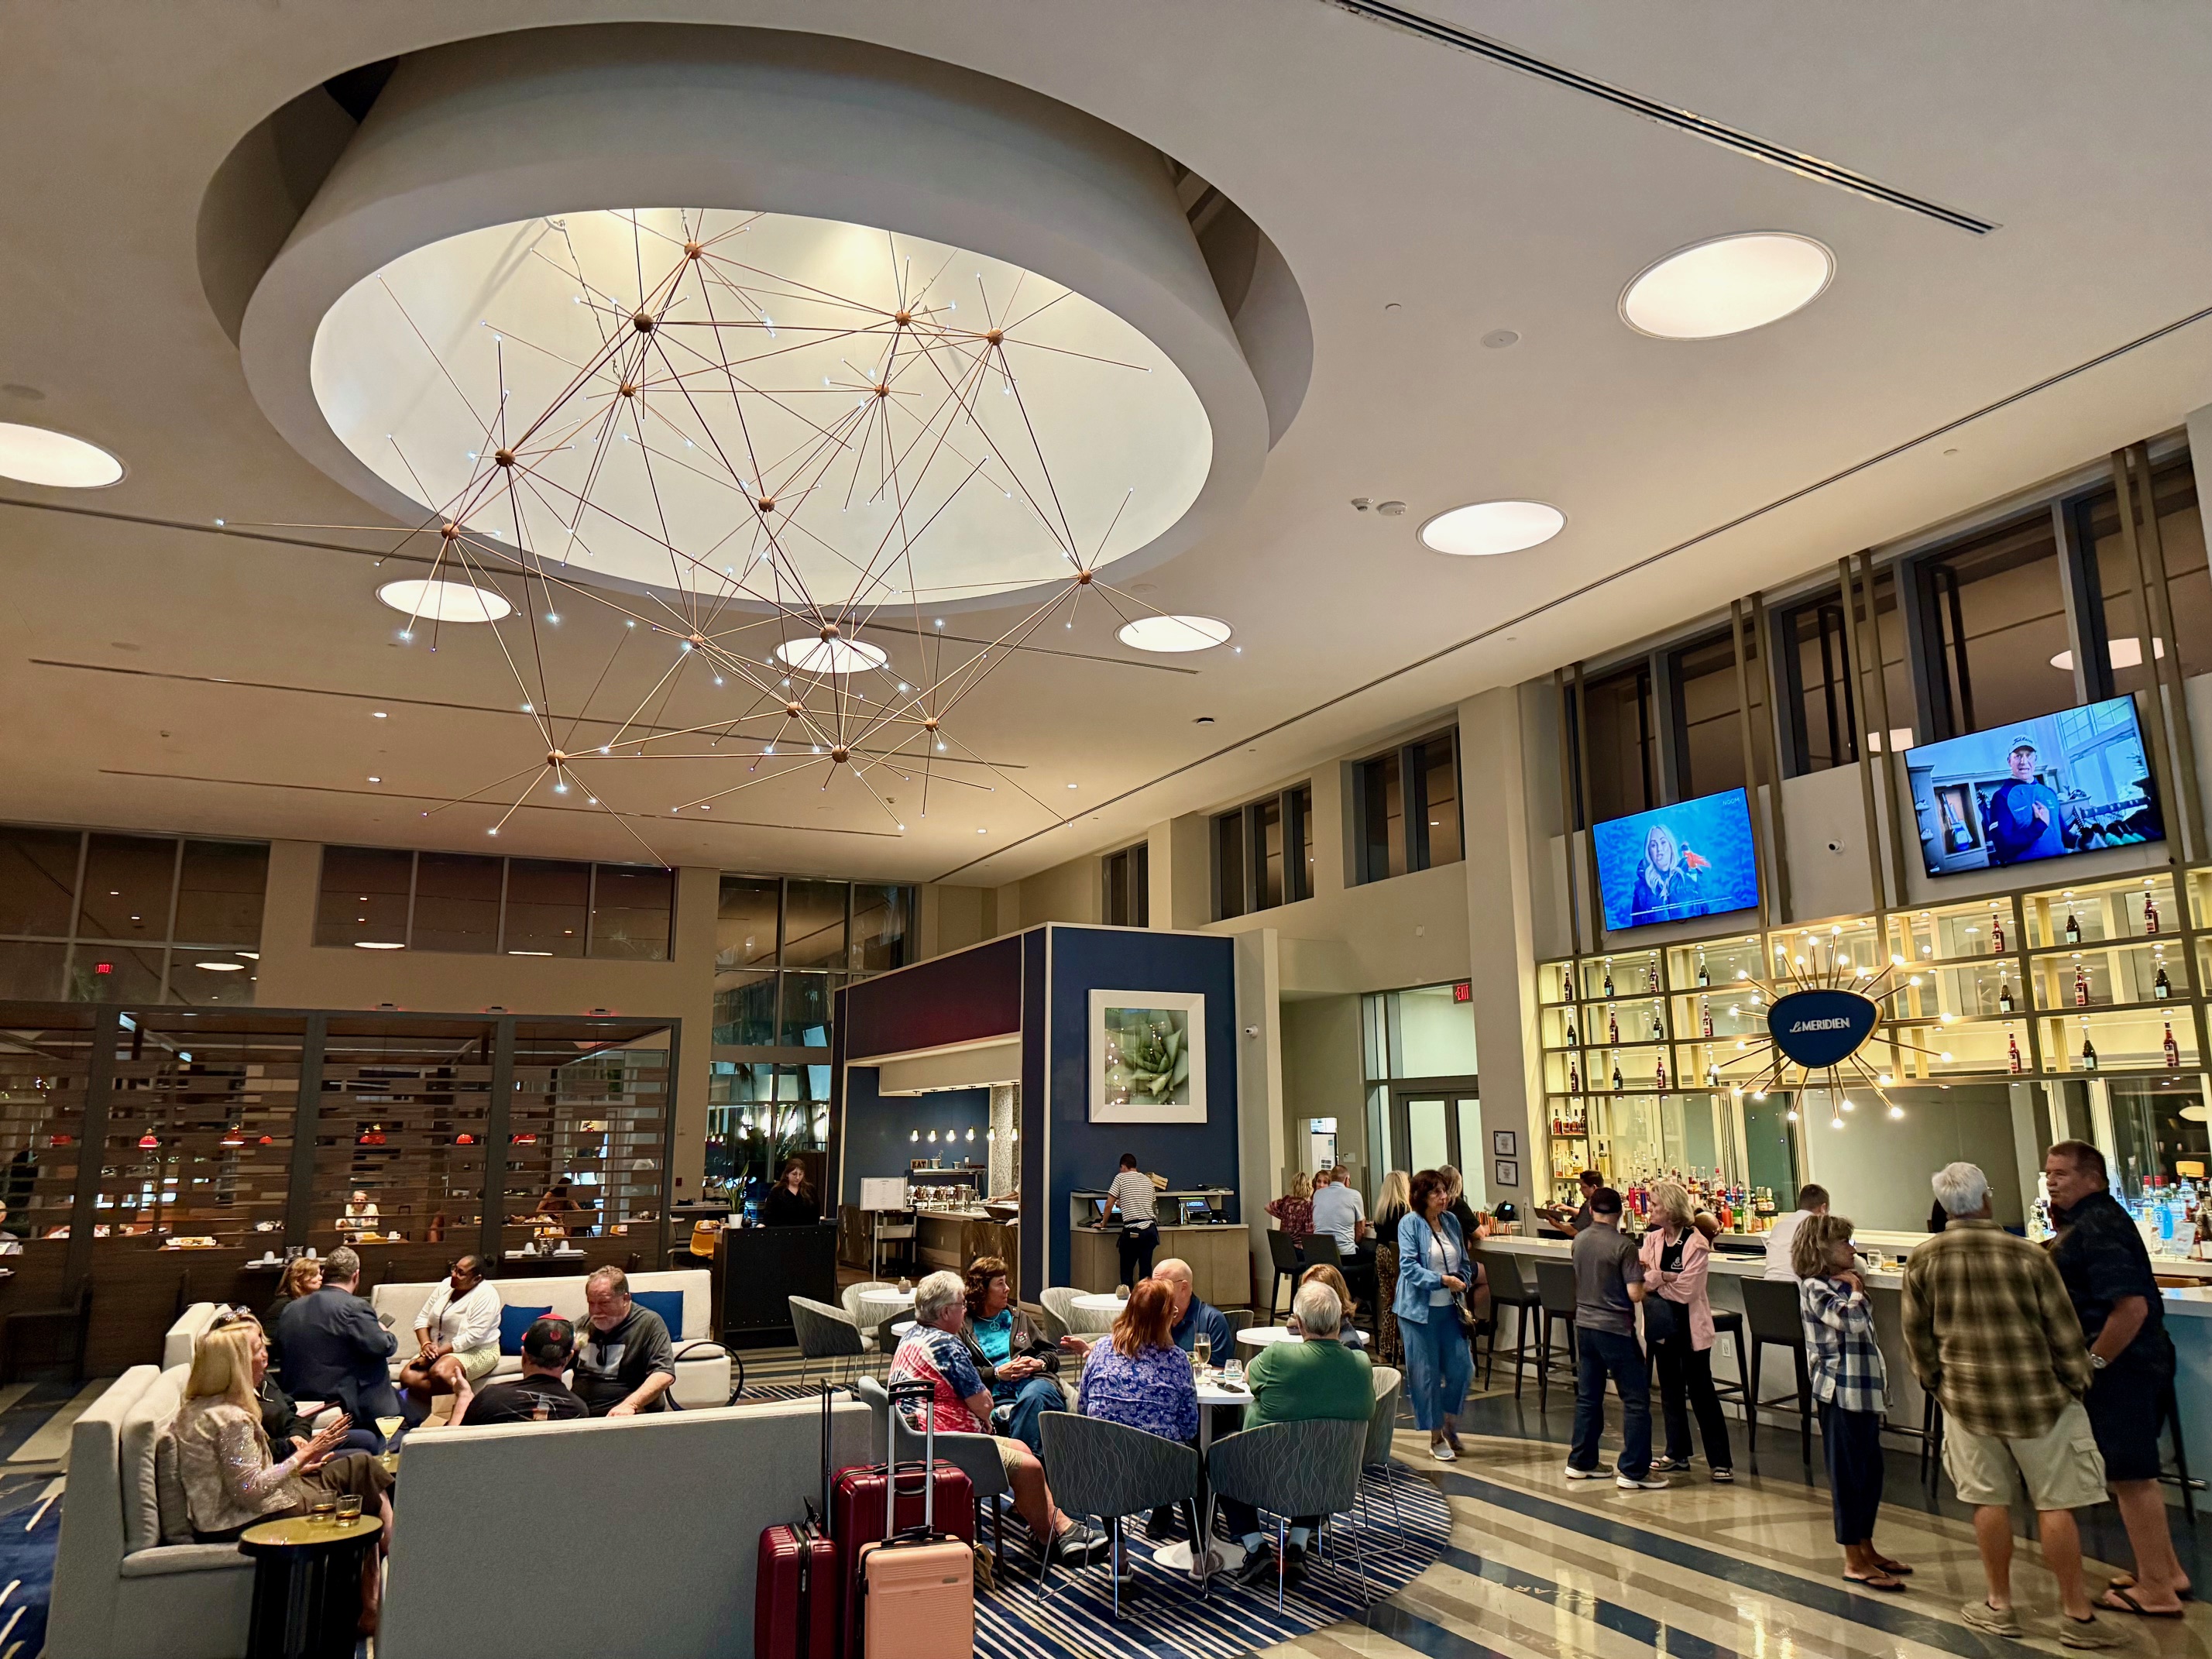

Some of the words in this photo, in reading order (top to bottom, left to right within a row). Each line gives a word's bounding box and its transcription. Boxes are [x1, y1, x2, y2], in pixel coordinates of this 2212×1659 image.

[1723, 797, 1740, 805] NOOM
[1457, 985, 1469, 1000] EXIT
[1802, 1017, 1850, 1032] MERIDIEN
